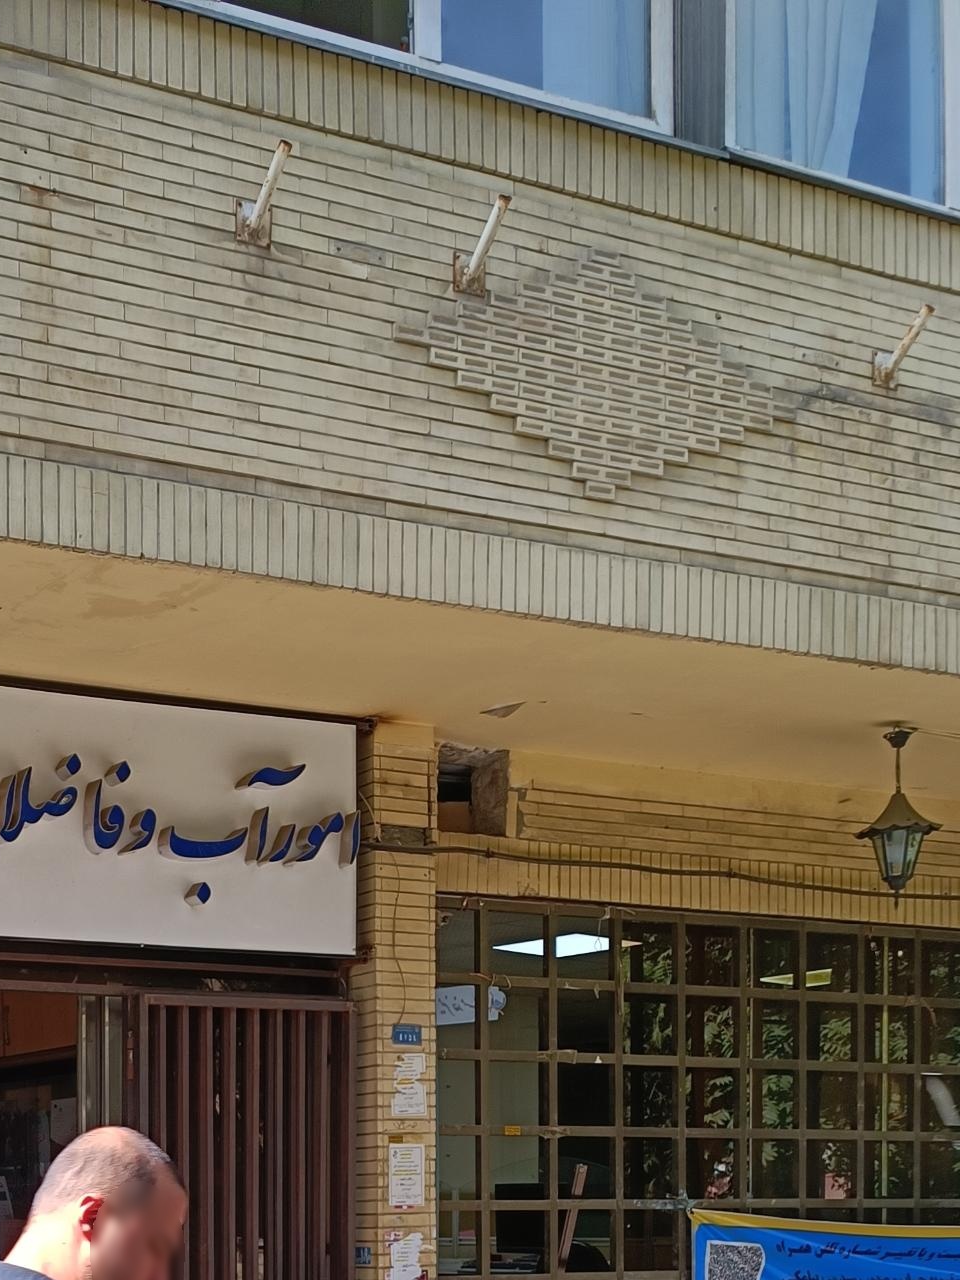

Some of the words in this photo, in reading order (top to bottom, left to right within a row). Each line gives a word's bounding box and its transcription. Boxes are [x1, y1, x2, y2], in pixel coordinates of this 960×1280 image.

[117, 808, 157, 857] و
[158, 763, 307, 908] آب
[257, 810, 361, 870] امور
